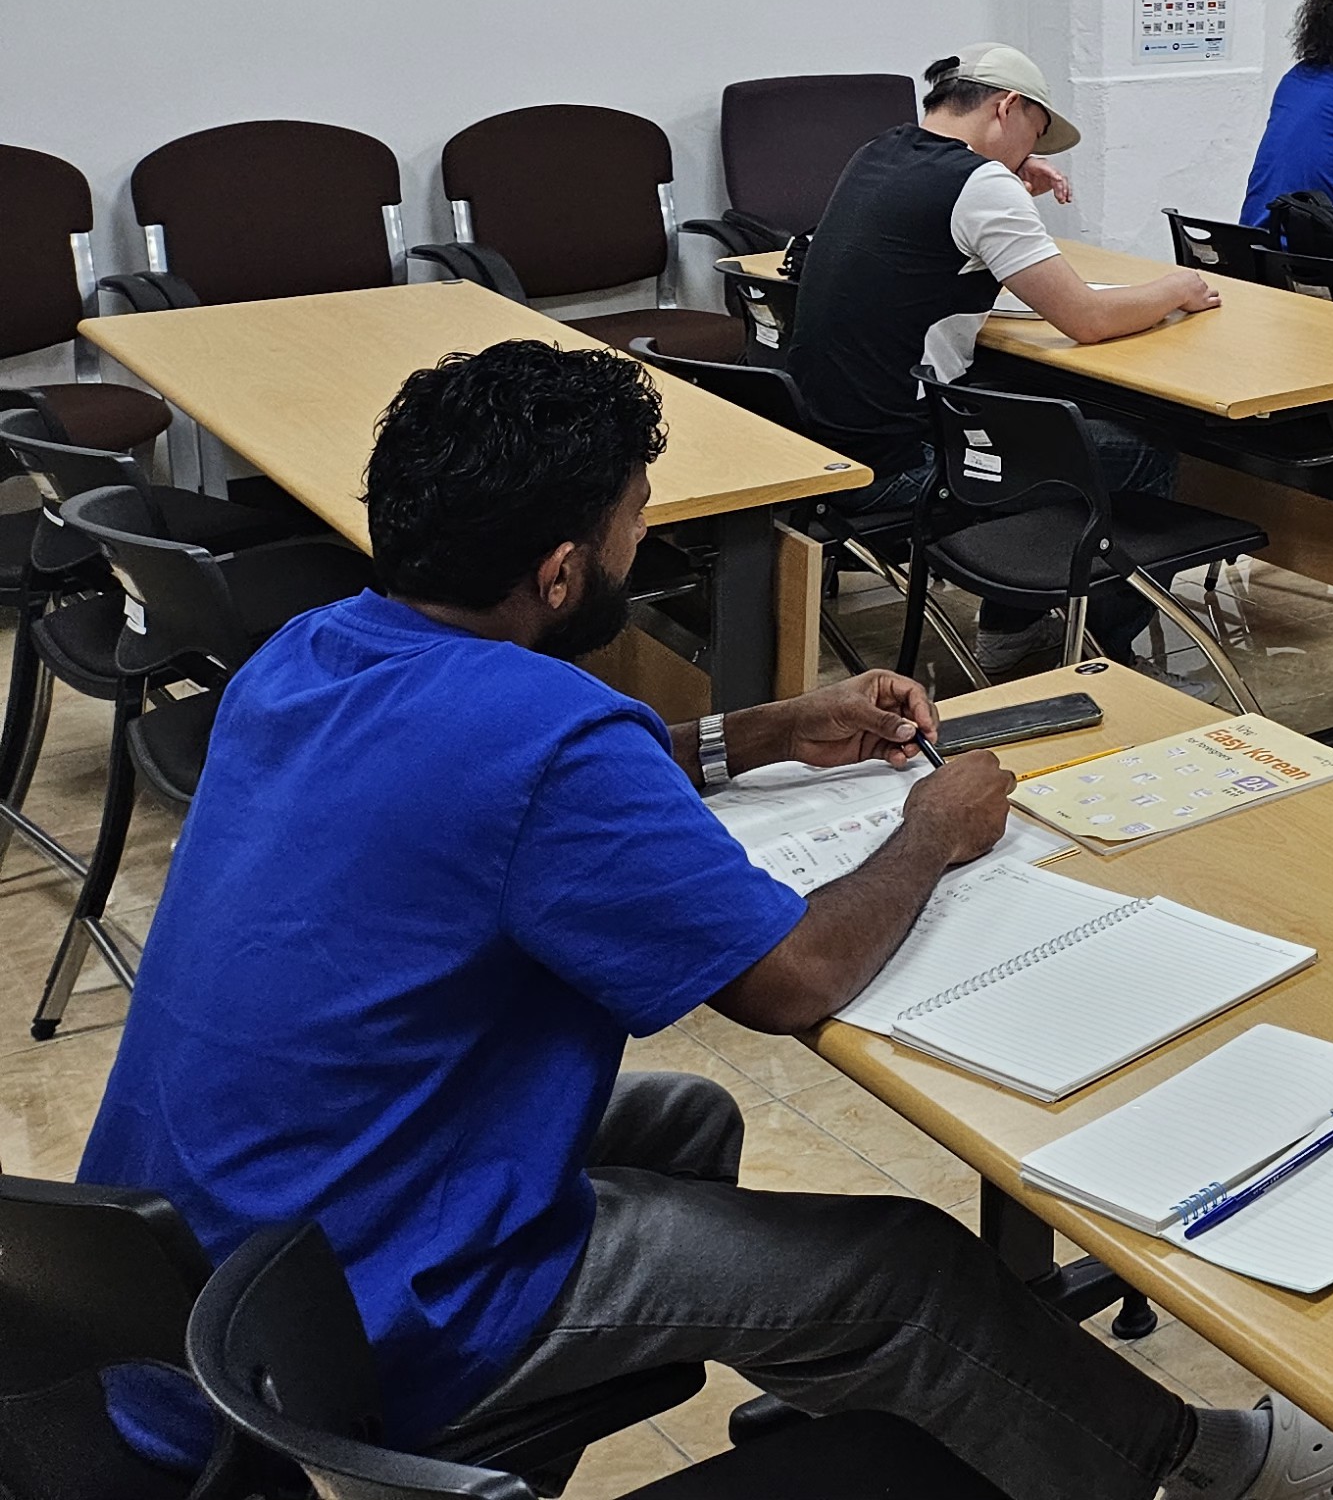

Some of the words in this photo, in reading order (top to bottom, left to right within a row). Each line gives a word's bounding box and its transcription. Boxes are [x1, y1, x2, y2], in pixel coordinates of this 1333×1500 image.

[1198, 739, 1233, 761] foreigners
[1204, 729, 1252, 751] Easy
[1243, 747, 1311, 780] Korean
[1243, 776, 1269, 792] 2A
